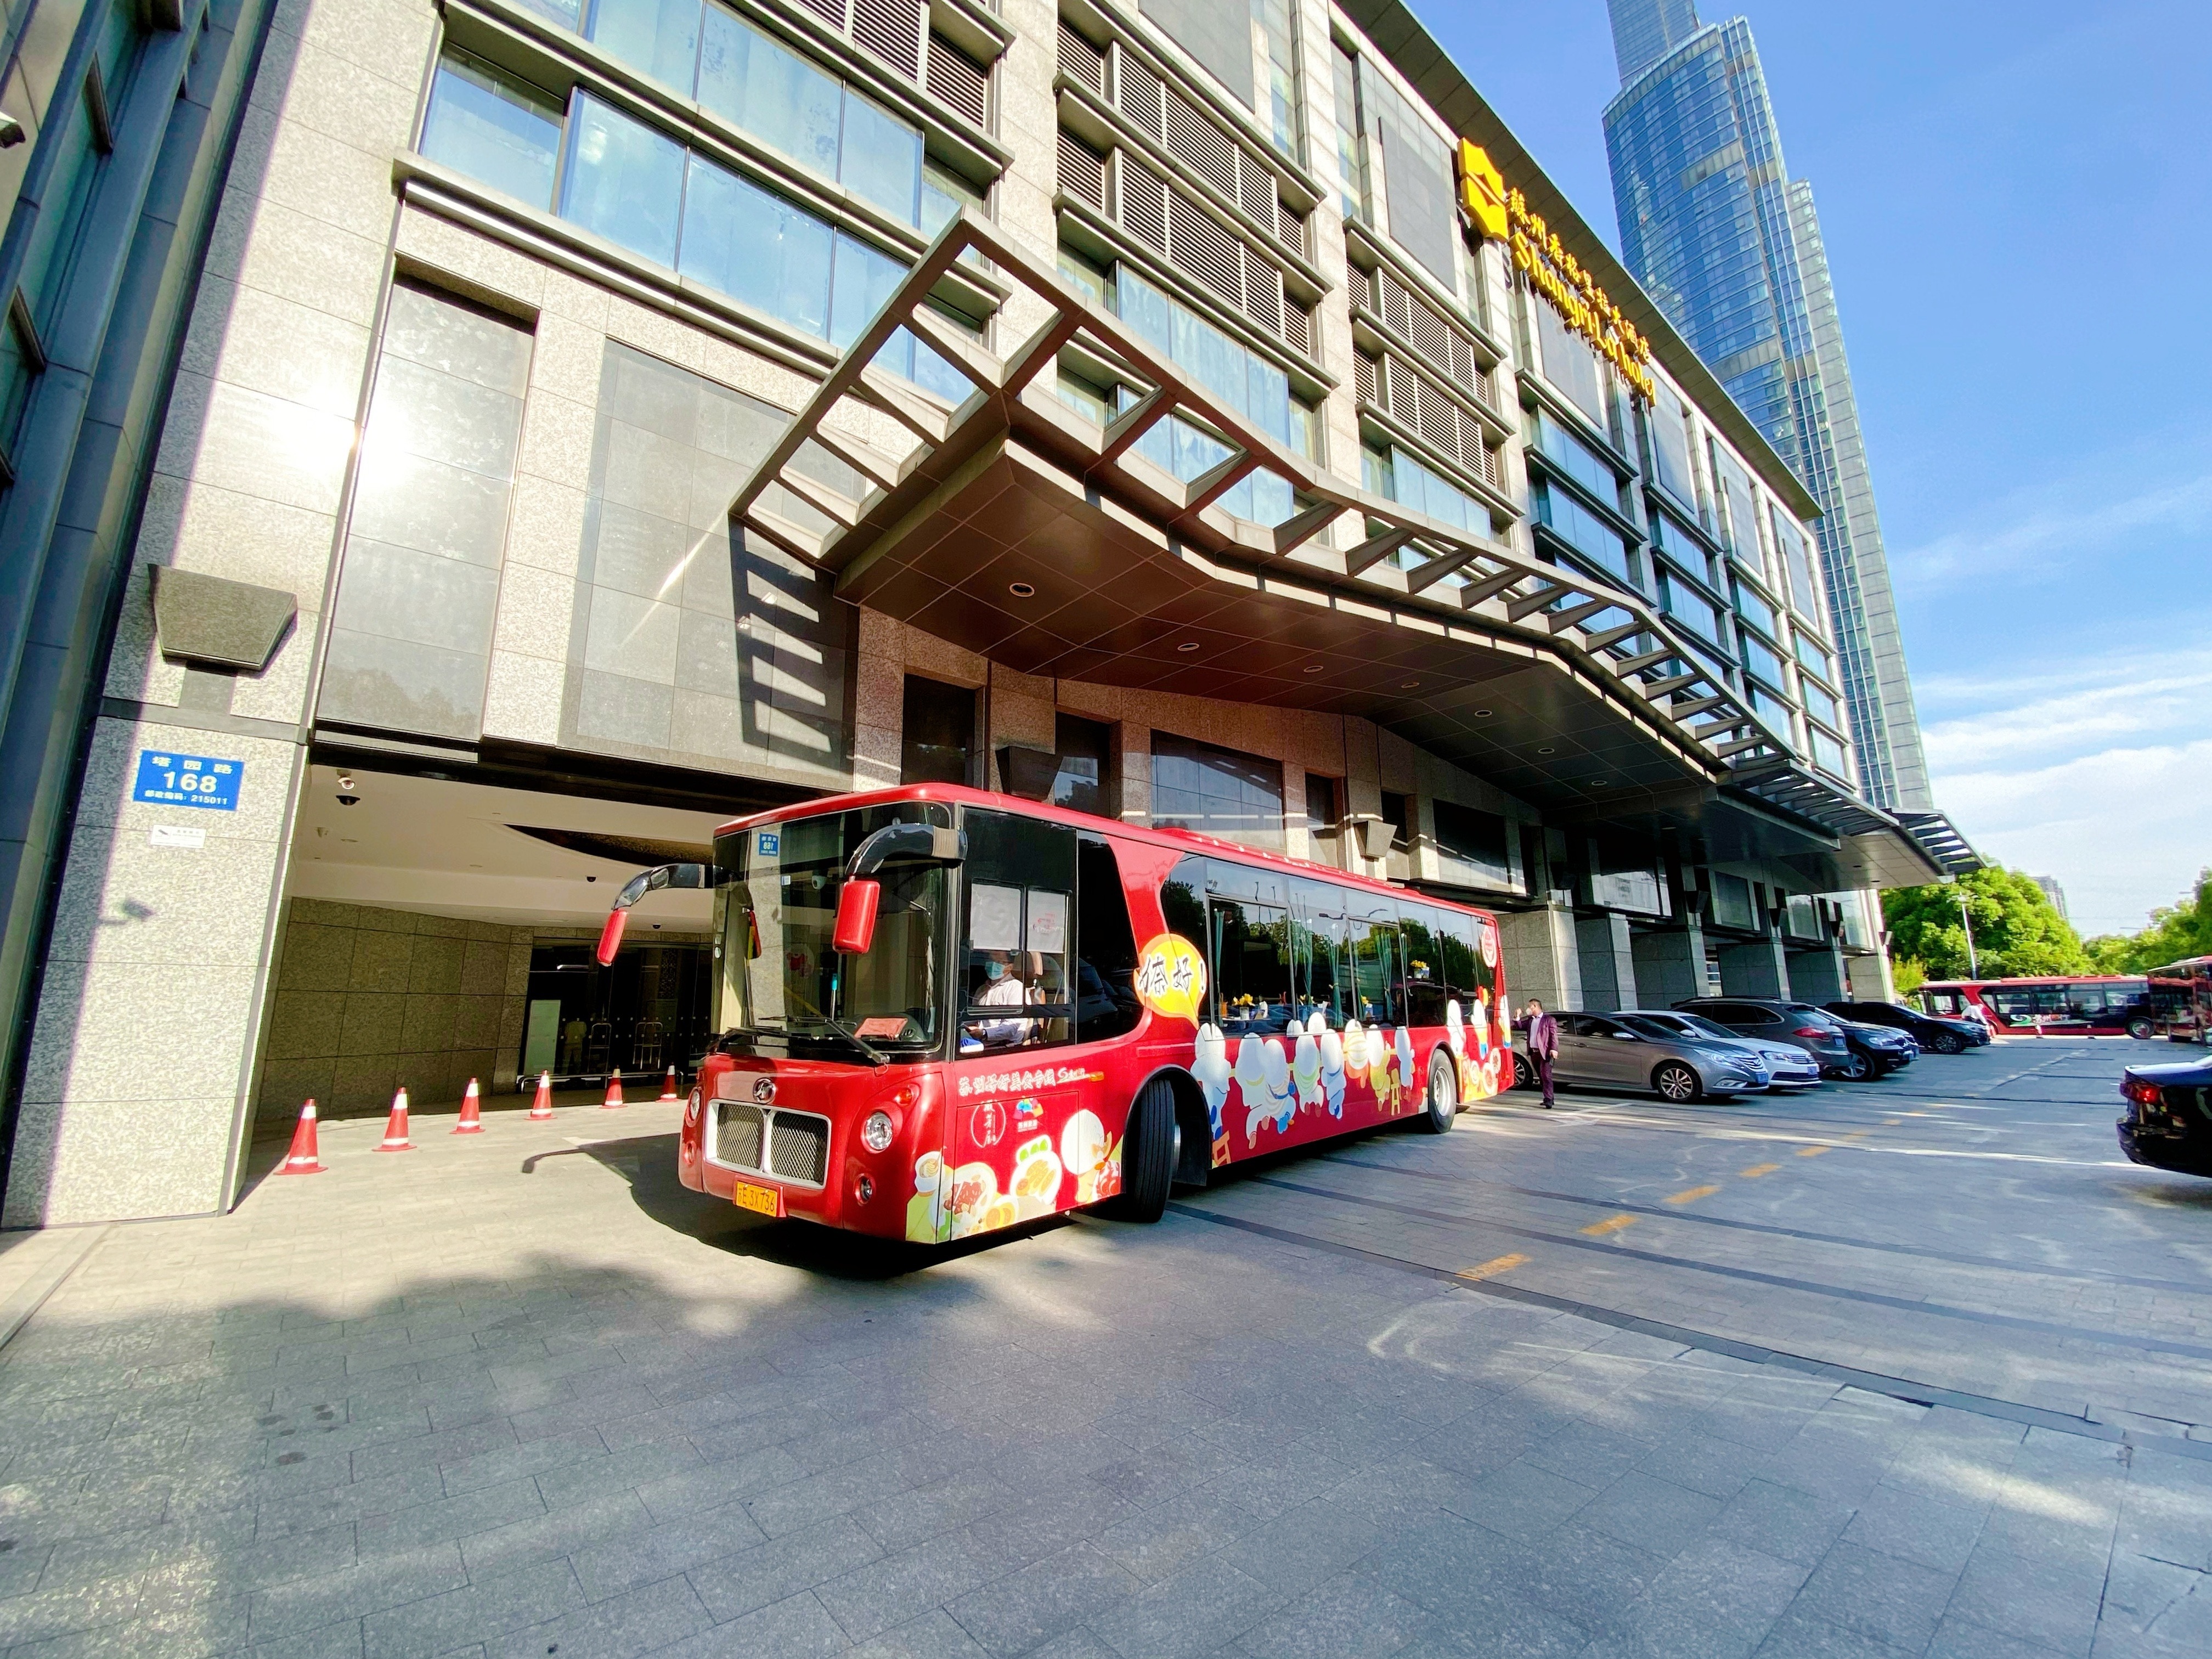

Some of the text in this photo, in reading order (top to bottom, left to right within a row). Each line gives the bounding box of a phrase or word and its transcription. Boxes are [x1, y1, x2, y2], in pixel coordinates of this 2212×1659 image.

[1513, 230, 1618, 362] Shangri-La
[163, 771, 217, 793] 168
[191, 794, 227, 805] 215011
[958, 1068, 1056, 1097] 苏州好行美食专线
